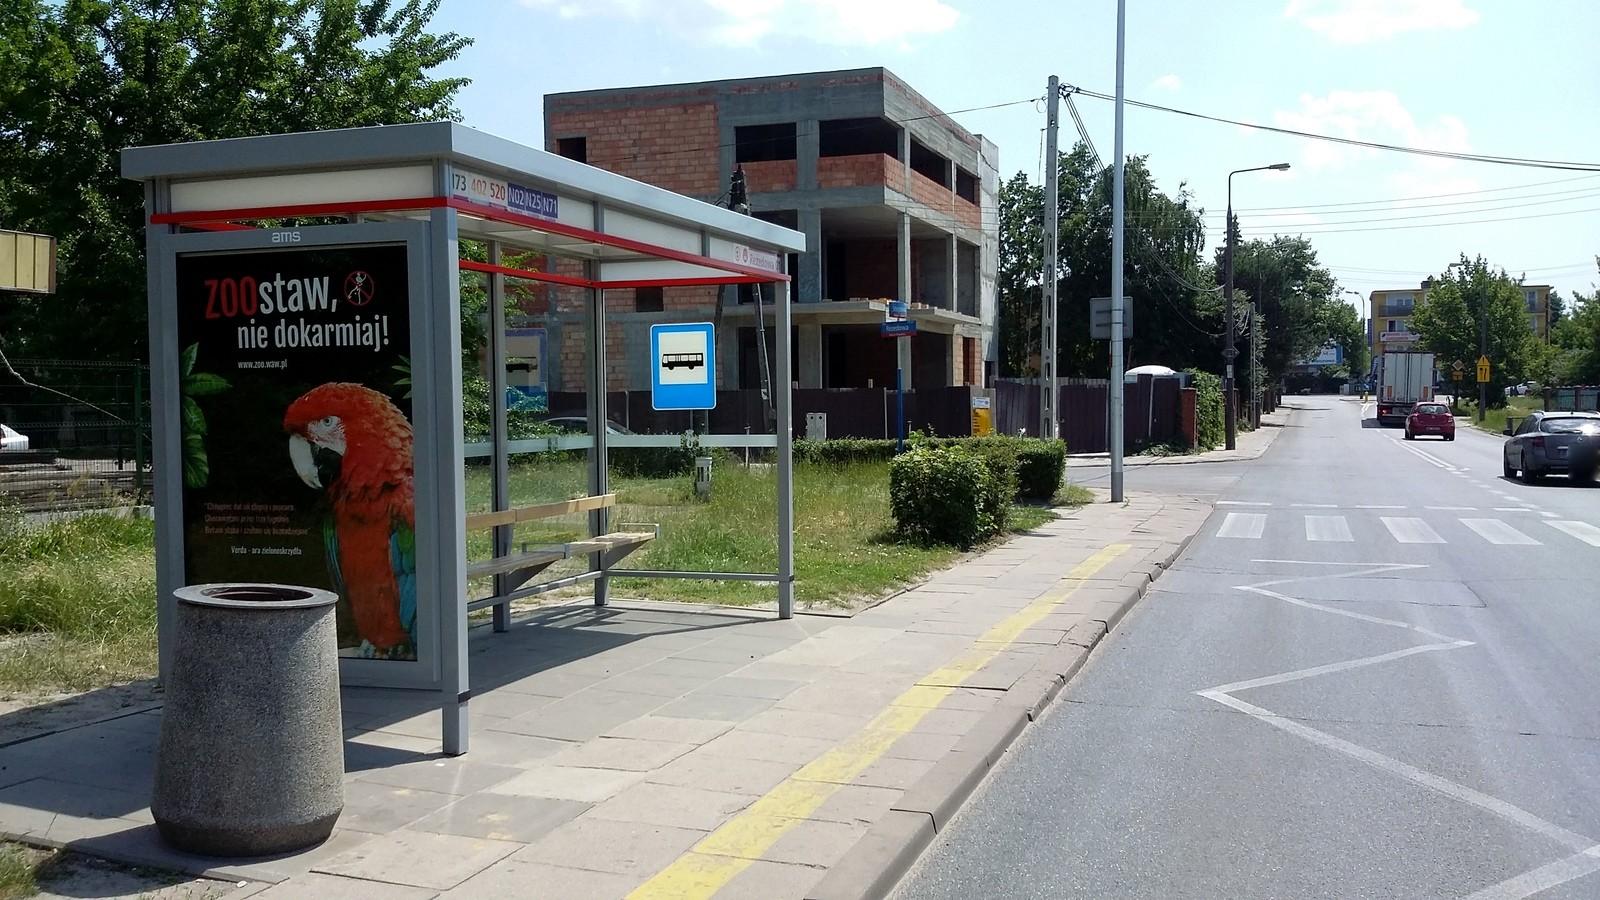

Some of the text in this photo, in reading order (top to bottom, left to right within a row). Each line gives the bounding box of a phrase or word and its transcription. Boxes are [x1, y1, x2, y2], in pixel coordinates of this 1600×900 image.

[451, 173, 558, 214] 173 402 520 N02 N25 N71
[271, 230, 301, 243] ams
[204, 272, 338, 320] ZOOstaw,
[237, 315, 390, 352] nie dokarmiaj!
[237, 359, 288, 370] www.zoo.waw.pl
